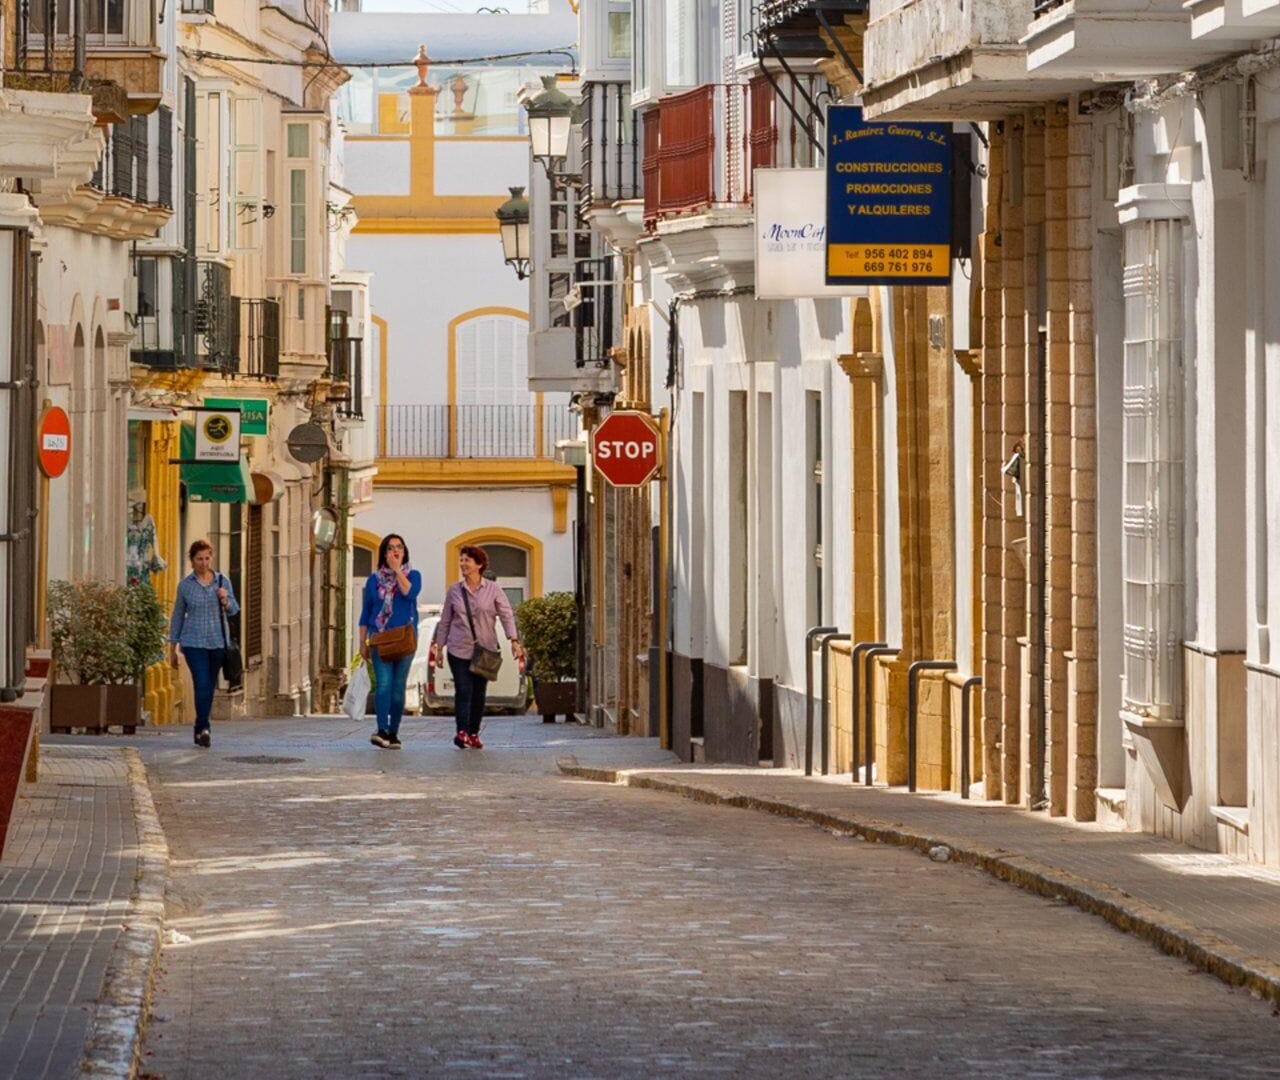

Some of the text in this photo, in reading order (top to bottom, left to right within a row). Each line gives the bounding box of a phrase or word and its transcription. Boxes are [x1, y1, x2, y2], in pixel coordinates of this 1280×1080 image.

[835, 162, 944, 174] CONSTRUCCIONES
[846, 183, 933, 195] PROMOCIONES
[848, 205, 931, 216] Y ALQUILERES
[864, 248, 885, 259] 956
[888, 248, 909, 259] 402
[912, 248, 933, 259] 894
[864, 262, 933, 272] 669 761 976
[597, 440, 654, 459] STOP
